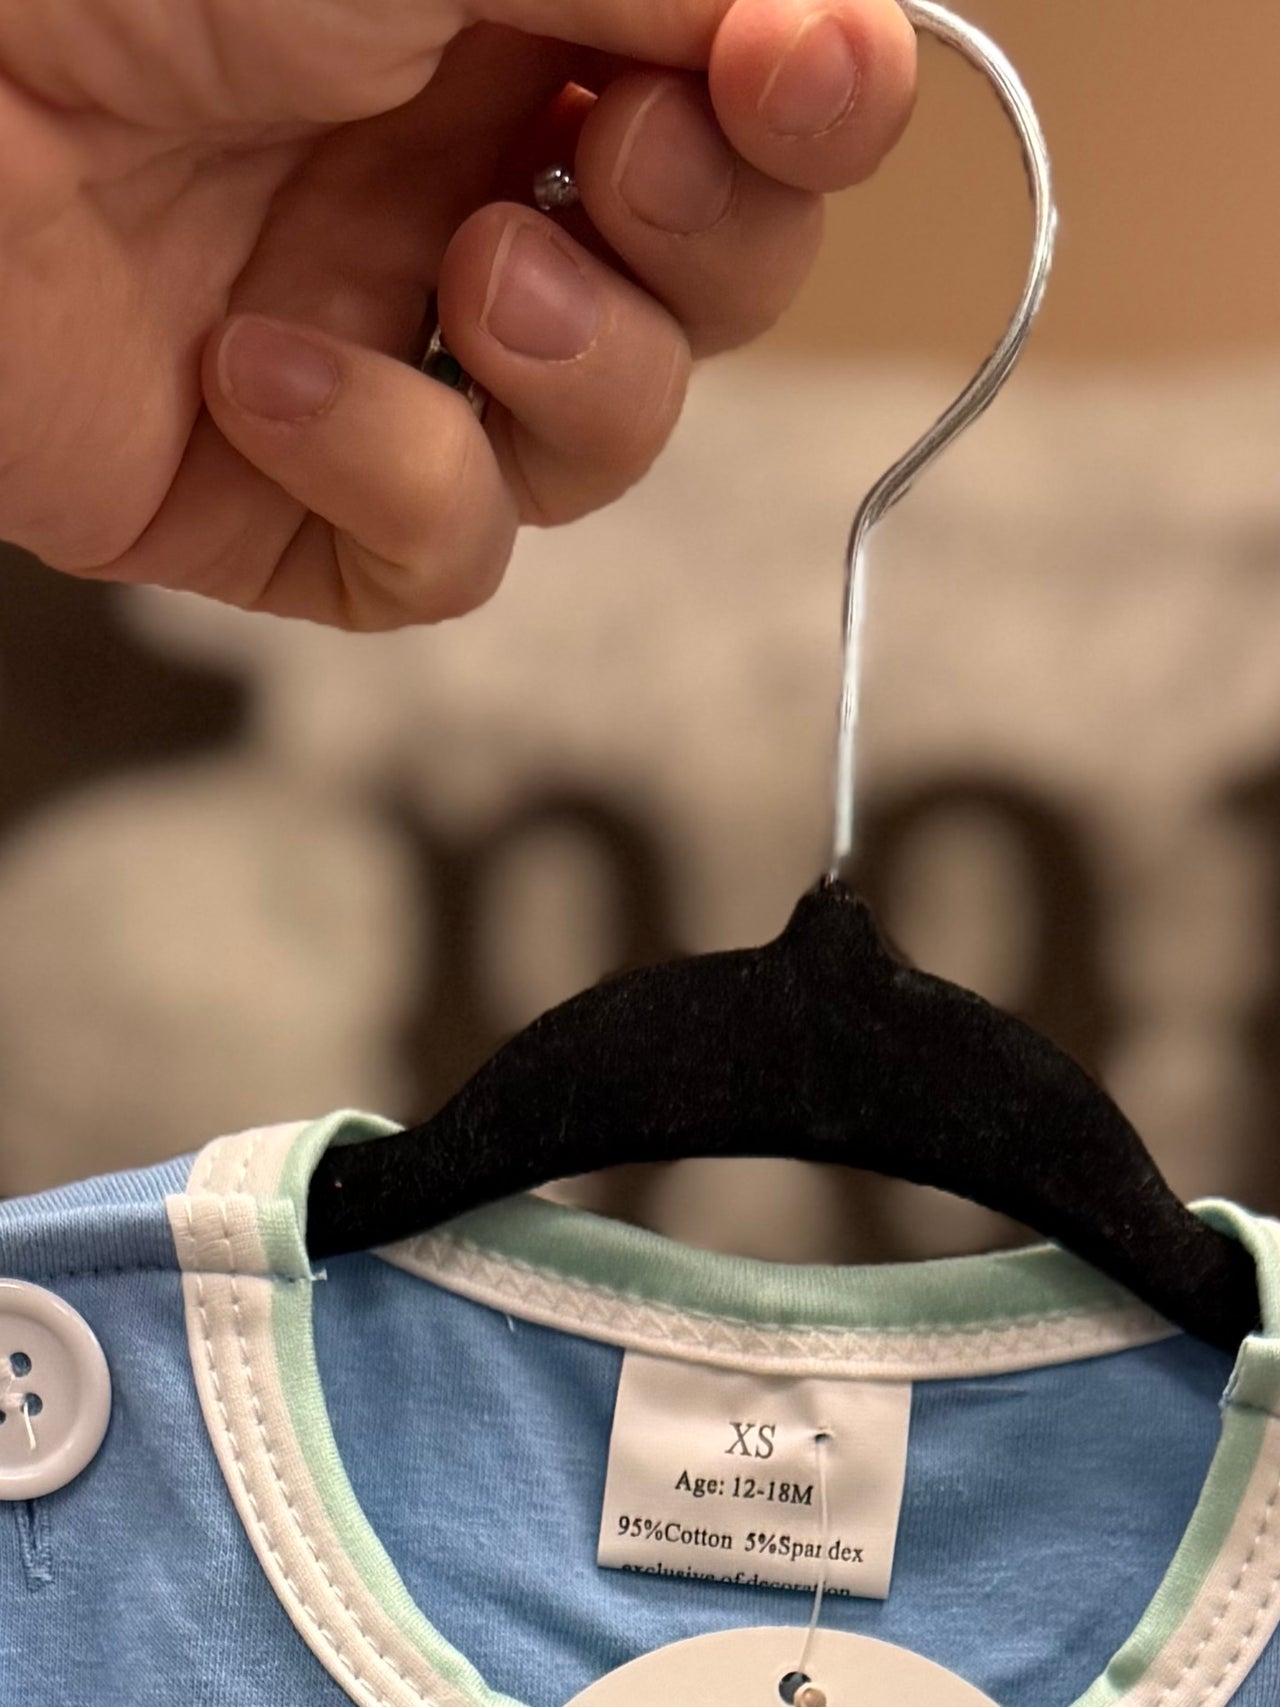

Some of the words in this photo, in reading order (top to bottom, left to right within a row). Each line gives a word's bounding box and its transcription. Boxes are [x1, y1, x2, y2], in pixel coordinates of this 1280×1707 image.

[725, 1421, 776, 1459] XS
[675, 1470, 724, 1498] Age:
[732, 1477, 813, 1506] 12-18M
[618, 1515, 733, 1550] 95%Cotton
